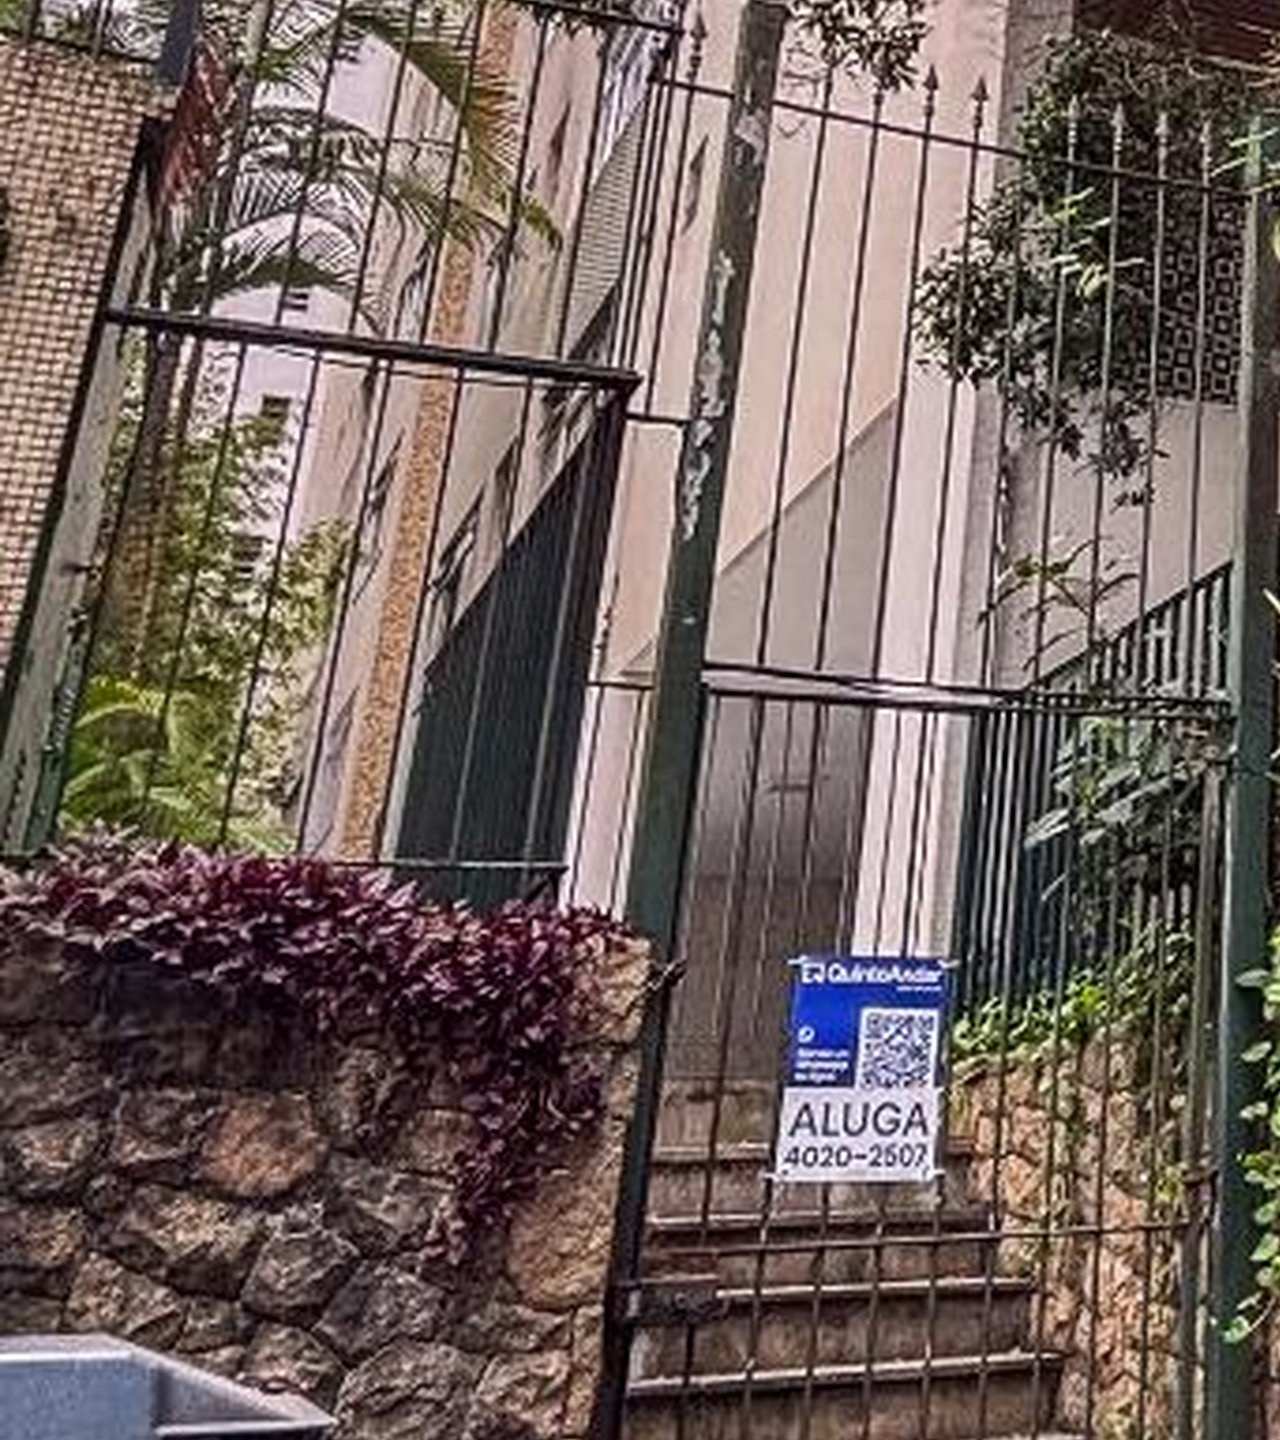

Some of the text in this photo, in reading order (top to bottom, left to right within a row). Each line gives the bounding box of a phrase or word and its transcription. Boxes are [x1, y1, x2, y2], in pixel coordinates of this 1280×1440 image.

[828, 963, 942, 983] QuintoAndar
[788, 1102, 928, 1137] ALUGA
[784, 1142, 928, 1168] 4020-2507
